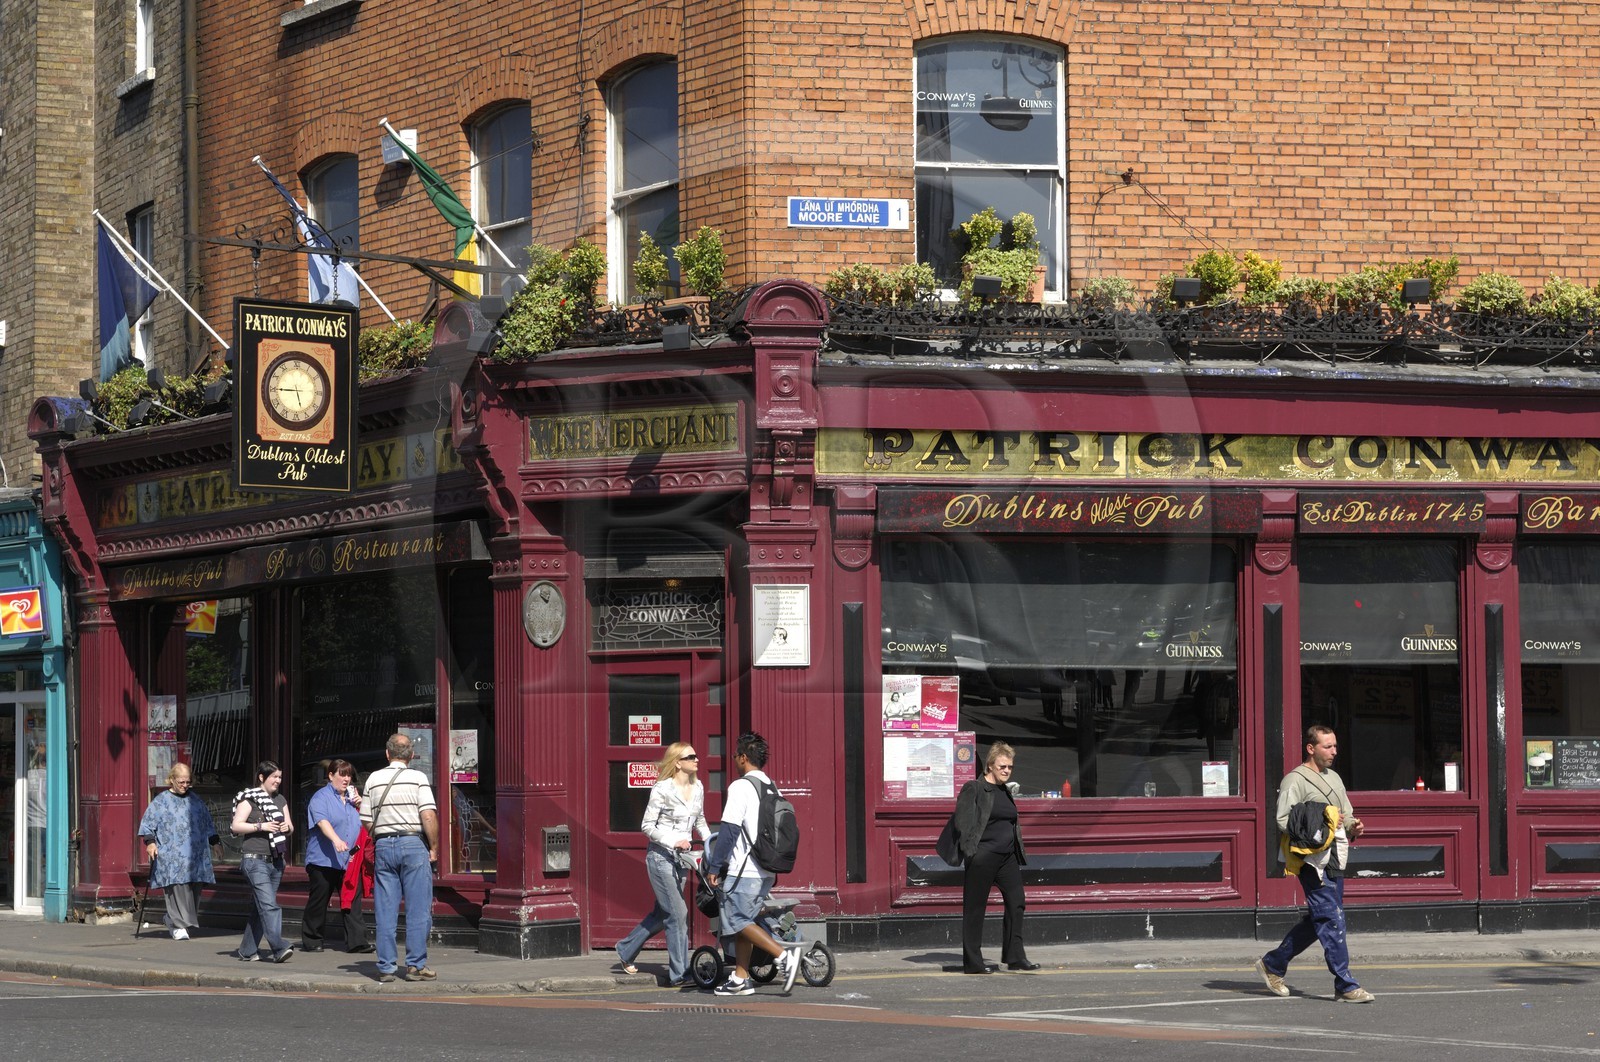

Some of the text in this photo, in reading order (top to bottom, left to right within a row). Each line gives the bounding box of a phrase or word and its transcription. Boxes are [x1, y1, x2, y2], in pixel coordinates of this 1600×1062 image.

[917, 91, 976, 102] CONWAY'S
[799, 200, 821, 212] LÁNA
[838, 201, 879, 213] MHÓRDHA
[897, 207, 902, 221] 1
[799, 212, 880, 224] MOORE LANE
[246, 313, 347, 338] PATRICK CONWAY'S
[305, 446, 346, 465] Oldest
[864, 430, 1243, 473] PATRICK
[943, 493, 1082, 528] Dublins
[1133, 495, 1206, 528] Pub
[1342, 501, 1418, 523] Dublin
[1422, 502, 1485, 522] 1745
[265, 548, 304, 580] Bar
[332, 532, 445, 572] Restaurant
[193, 558, 223, 588] Pub
[631, 592, 695, 607] PATRICK
[629, 608, 690, 623] CONWAY
[887, 641, 947, 653] CONWAY'S
[1401, 636, 1457, 651] GUINNESS
[1524, 640, 1582, 650] CONWAY'S
